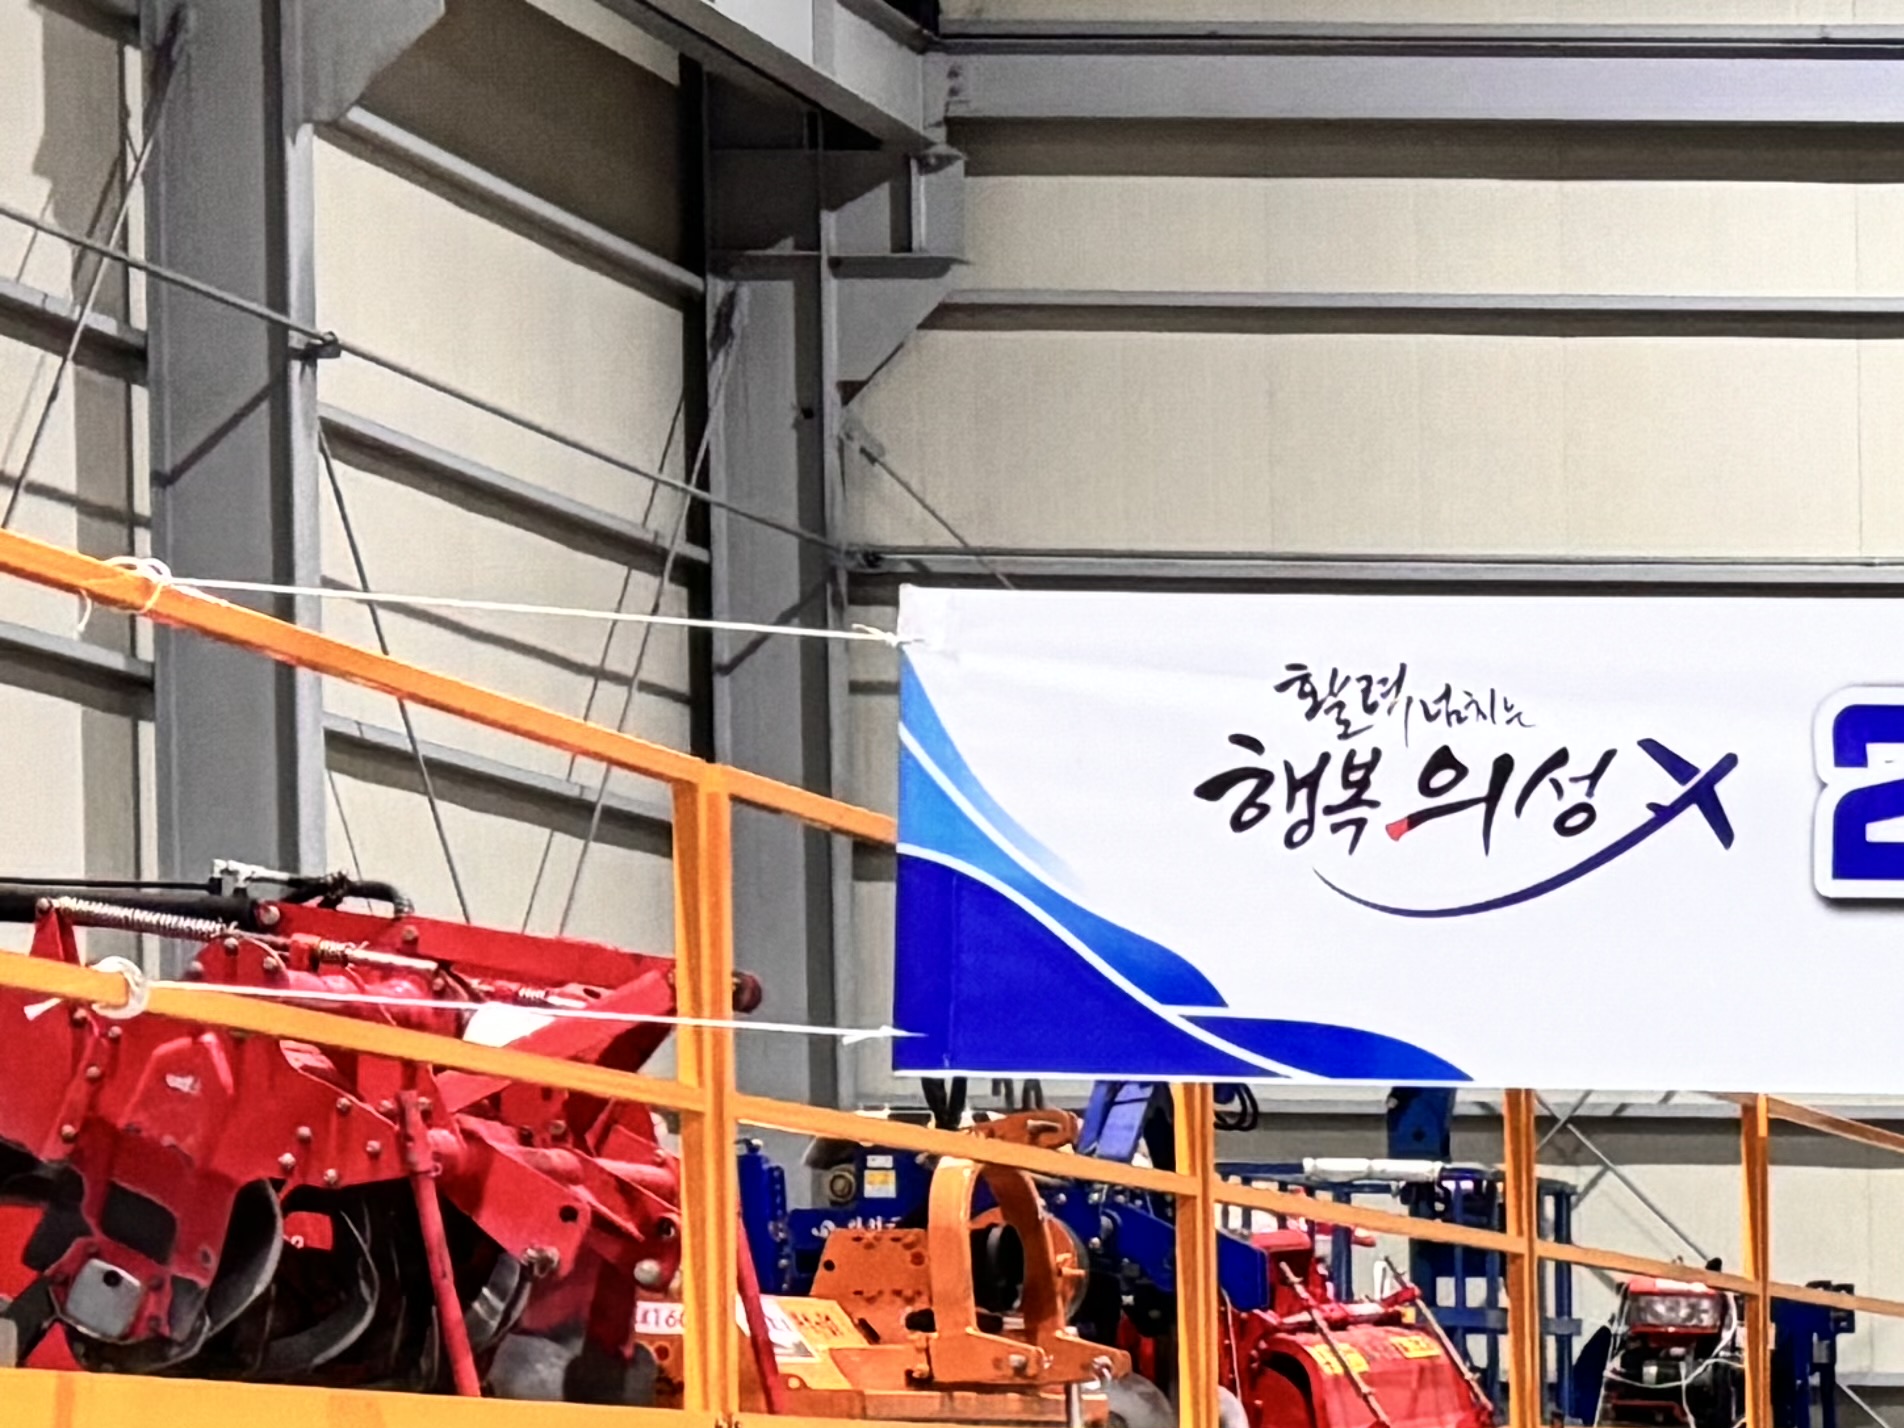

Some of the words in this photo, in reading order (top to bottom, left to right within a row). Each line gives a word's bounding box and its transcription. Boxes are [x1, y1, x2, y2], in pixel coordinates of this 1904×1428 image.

[1273, 661, 1408, 747] 활력
[1193, 733, 1382, 856] 행복
[1386, 744, 1618, 856] 의성
